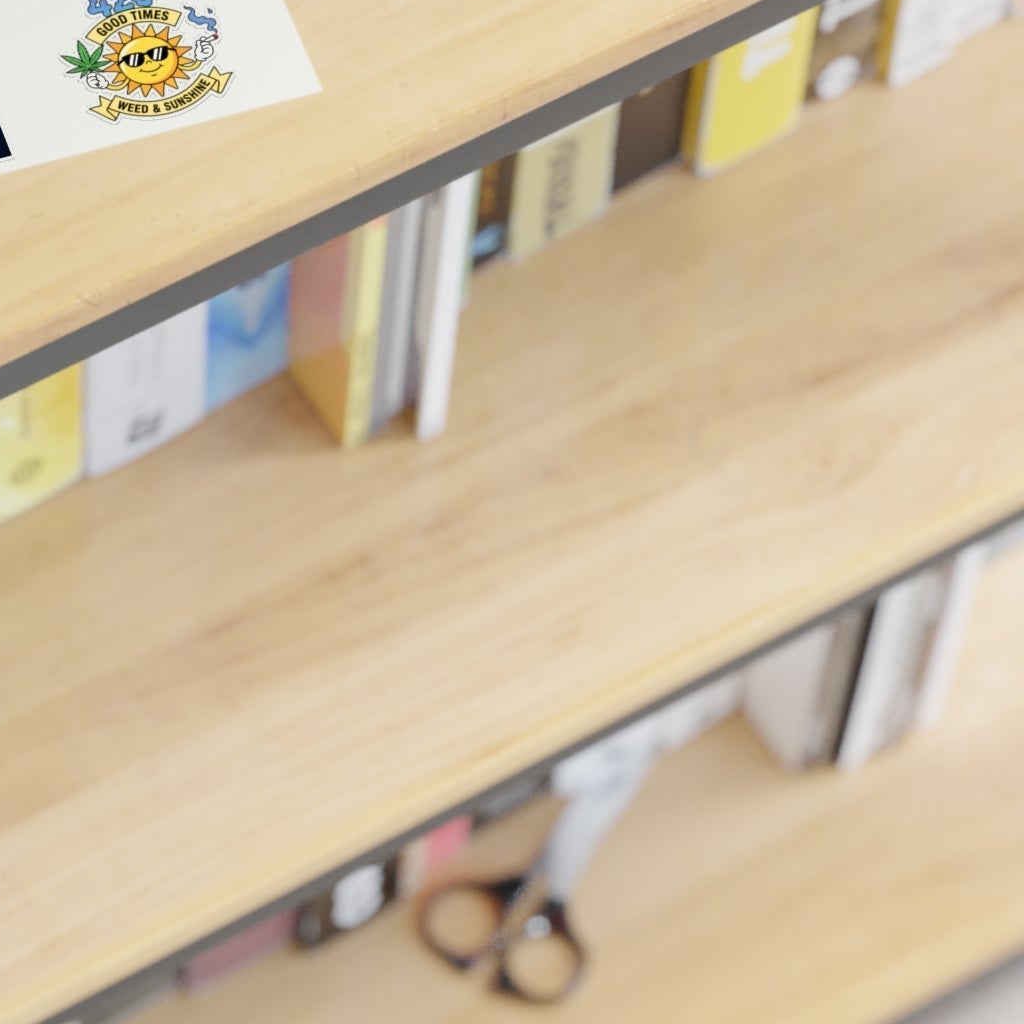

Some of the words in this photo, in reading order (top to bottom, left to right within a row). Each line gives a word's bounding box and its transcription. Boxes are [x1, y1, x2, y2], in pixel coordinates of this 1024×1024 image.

[96, 14, 128, 37] GOOD
[130, 9, 170, 22] TIMES
[117, 99, 149, 114] WEED
[152, 103, 161, 113] &
[163, 77, 211, 112] SUNSHINE
